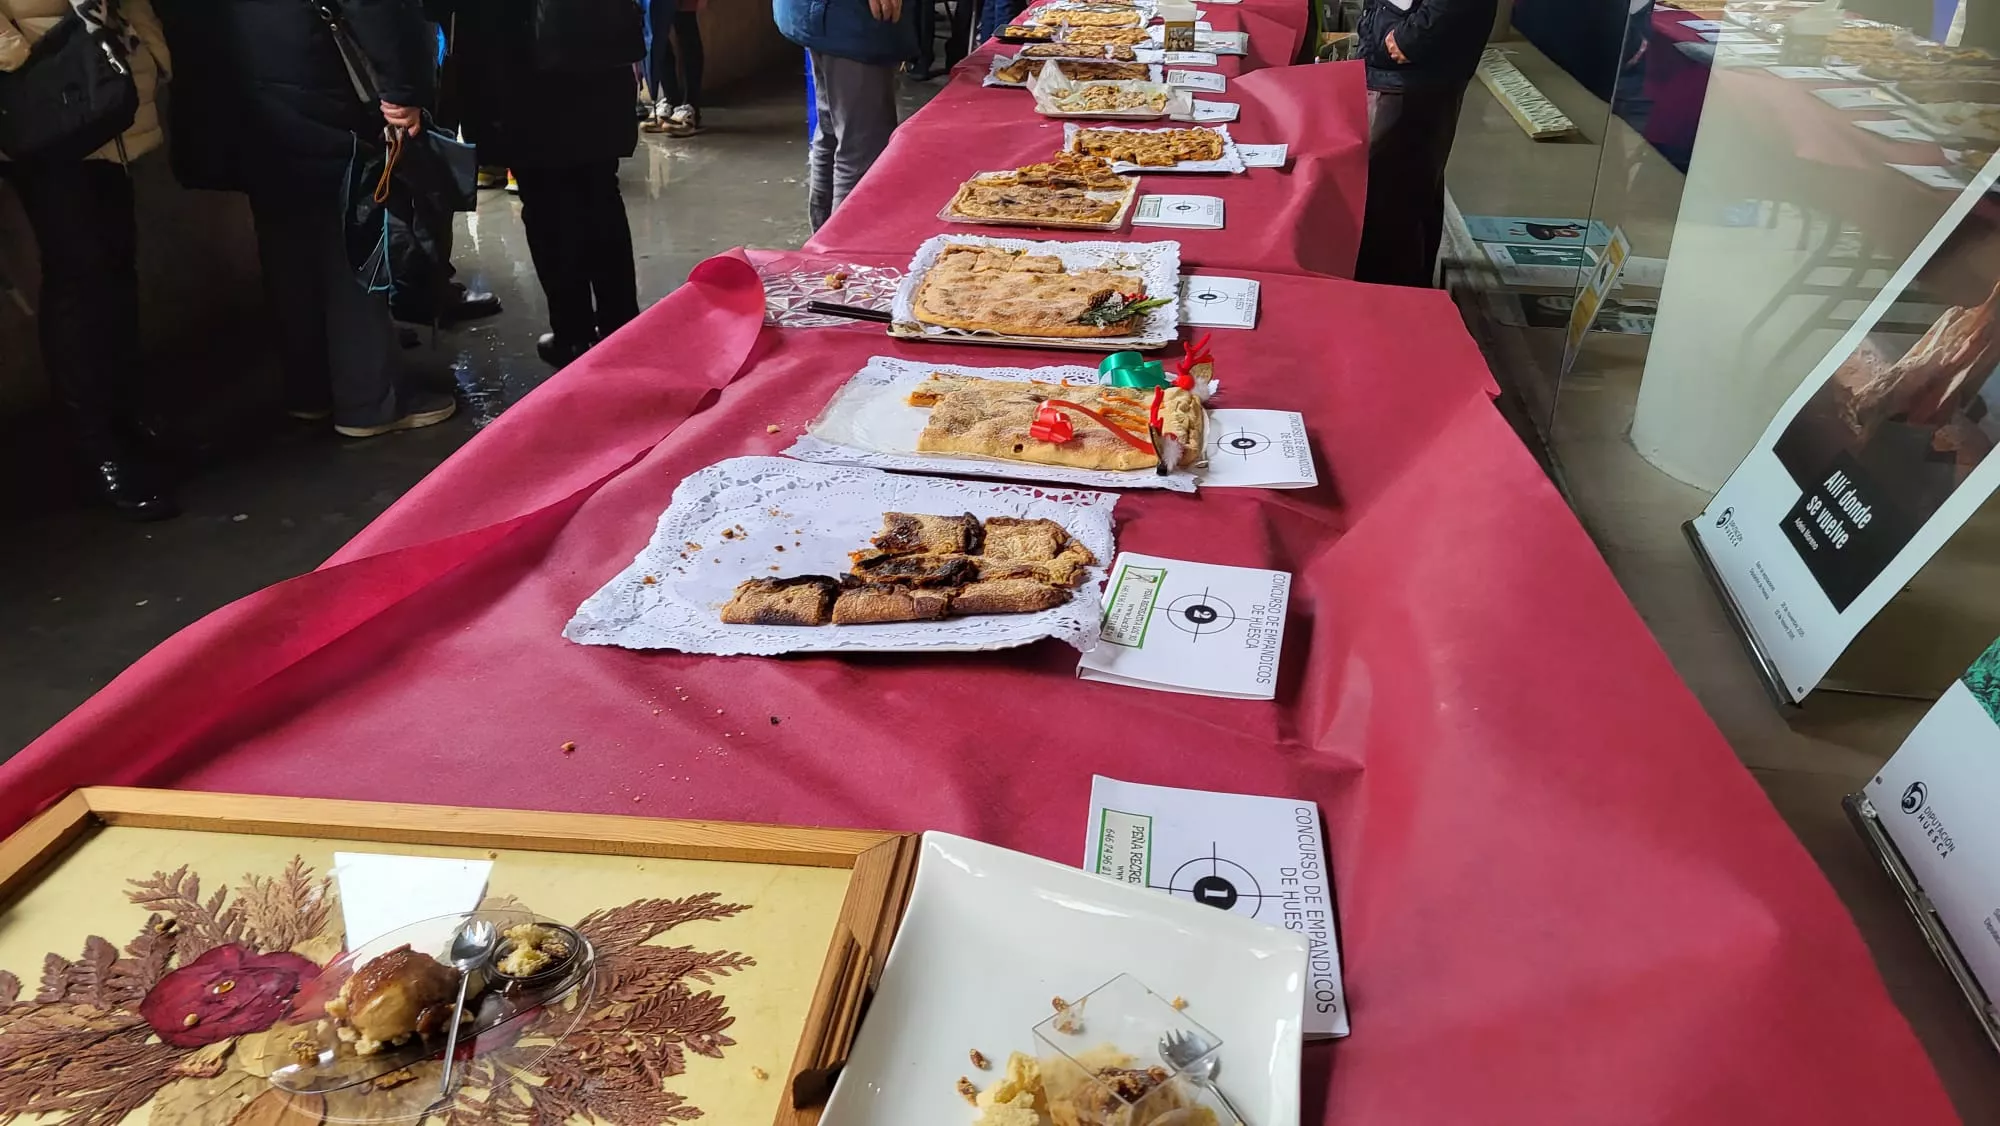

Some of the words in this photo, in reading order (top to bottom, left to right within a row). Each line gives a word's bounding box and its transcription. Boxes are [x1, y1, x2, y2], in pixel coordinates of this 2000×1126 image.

[1823, 470, 1851, 498] Allí
[1838, 488, 1872, 529] donde
[1806, 495, 1822, 516] se
[1816, 507, 1849, 549] vuelve
[1193, 609, 1212, 619] 2
[1251, 604, 1265, 616] DE
[1267, 573, 1286, 614] CONCURSO
[1245, 617, 1263, 649] HUESCA
[1266, 615, 1280, 627] DE
[1256, 629, 1278, 684] EMPANDICOS
[1295, 807, 1320, 879] CONCURSO
[1917, 813, 1948, 859] HUESCA
[1924, 806, 1955, 852] DIPUTACIÓN
[1204, 887, 1229, 899] 1
[1280, 867, 1298, 885] DE
[1303, 885, 1323, 904] DE
[1282, 891, 1304, 932] HUES
[1306, 910, 1336, 1014] EMPANDICOS
